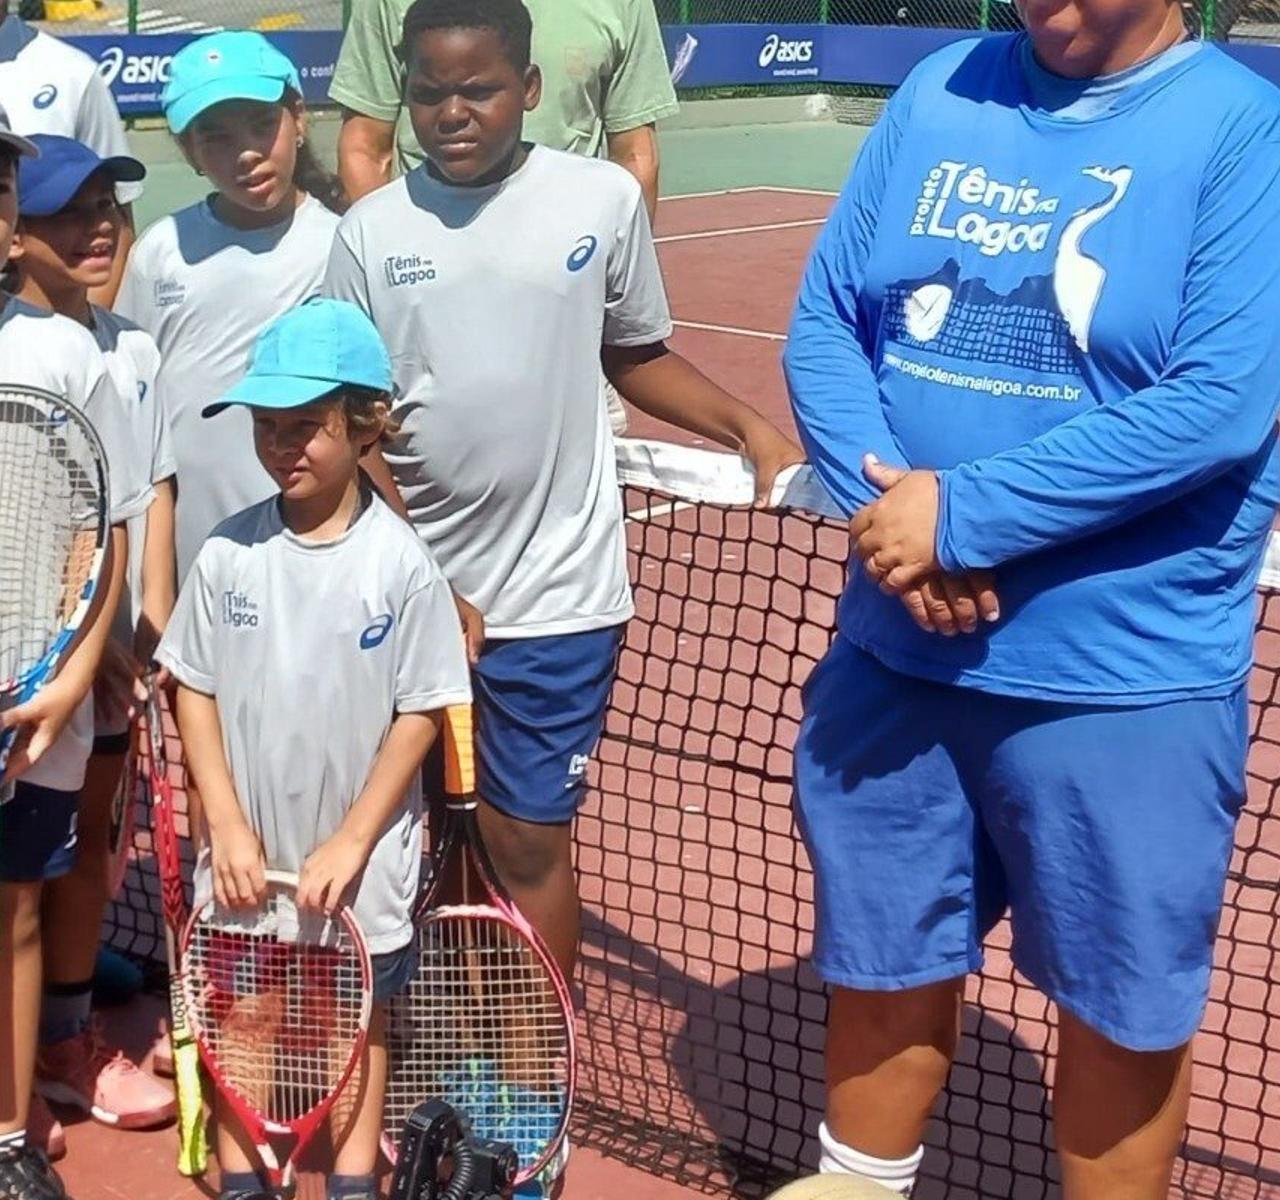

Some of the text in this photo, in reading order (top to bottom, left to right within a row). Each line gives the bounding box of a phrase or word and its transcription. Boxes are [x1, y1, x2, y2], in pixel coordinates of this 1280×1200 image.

[121, 55, 172, 84] asic
[938, 160, 1041, 216] Tênis
[926, 197, 1053, 258] Lagoa
[386, 254, 422, 271] Tênis
[391, 268, 436, 286] Lagoa
